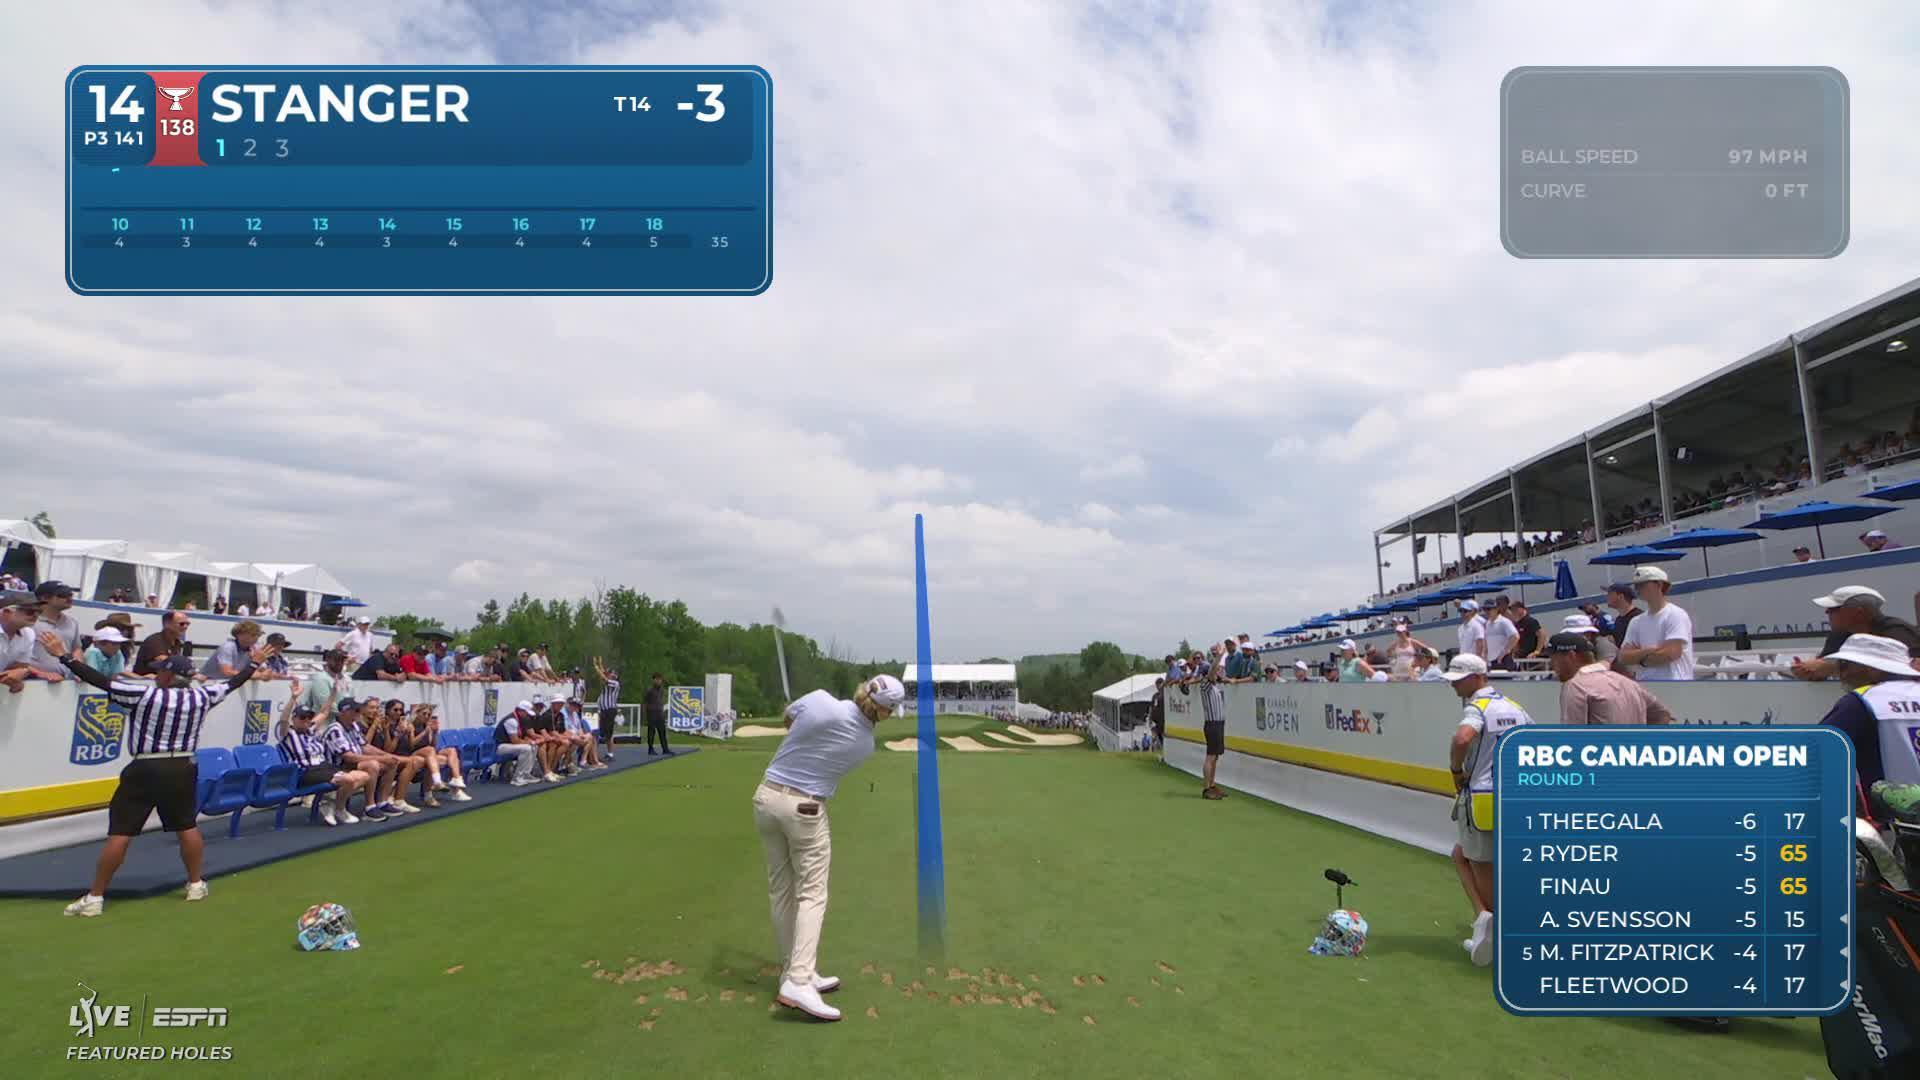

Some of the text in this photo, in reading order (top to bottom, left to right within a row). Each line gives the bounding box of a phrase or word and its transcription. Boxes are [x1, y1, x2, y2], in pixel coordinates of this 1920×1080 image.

[672, 717, 700, 728] RBC
[1267, 712, 1299, 732] OPEN
[1336, 708, 1370, 734] FedEx
[244, 732, 267, 744] RBC
[75, 742, 118, 761] RBC
